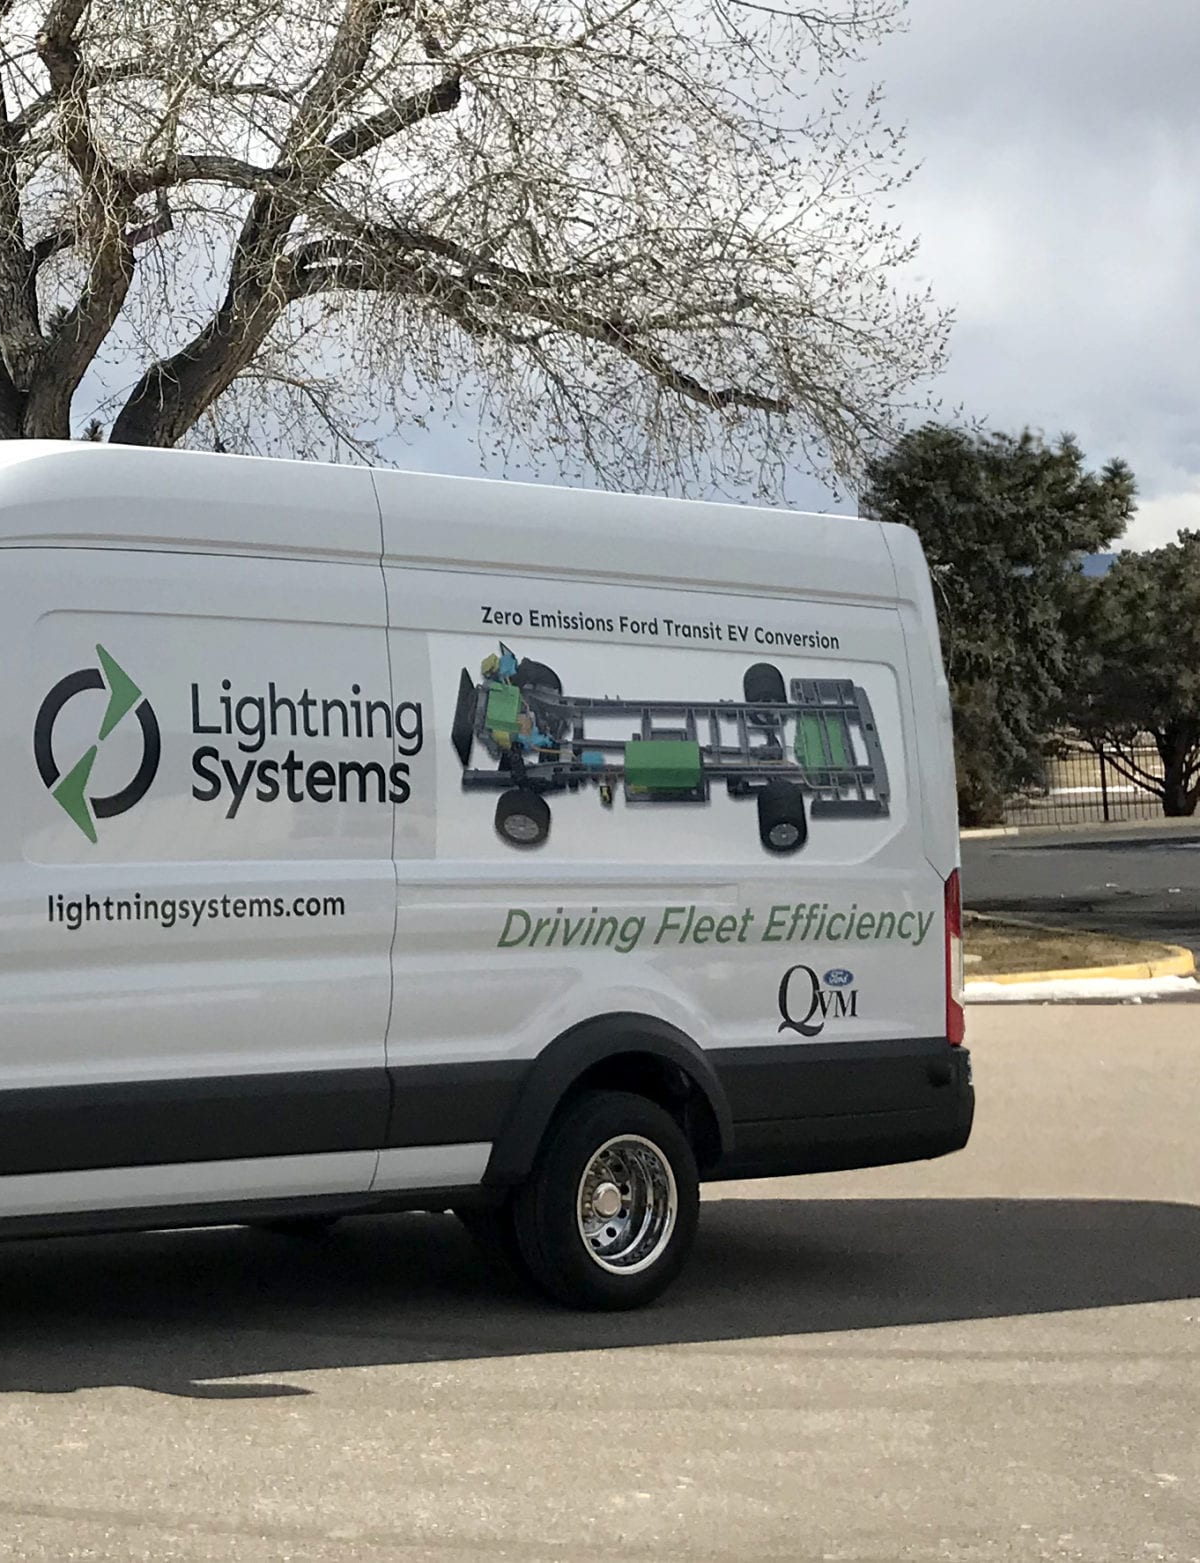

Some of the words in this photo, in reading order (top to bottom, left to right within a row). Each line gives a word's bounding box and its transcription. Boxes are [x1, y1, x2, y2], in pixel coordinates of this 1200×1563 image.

[480, 606, 523, 626] Zero
[529, 609, 614, 632] Emissions
[619, 616, 658, 635] Ford
[663, 619, 722, 640] Transit
[728, 625, 749, 642] EV
[754, 627, 840, 649] Conversion
[191, 680, 424, 756] Lightning
[191, 746, 412, 819] Systems
[47, 892, 346, 931] lightningsystems.com
[497, 906, 647, 954] Driving
[652, 904, 755, 945] Fleet
[760, 902, 935, 946] Efficiency
